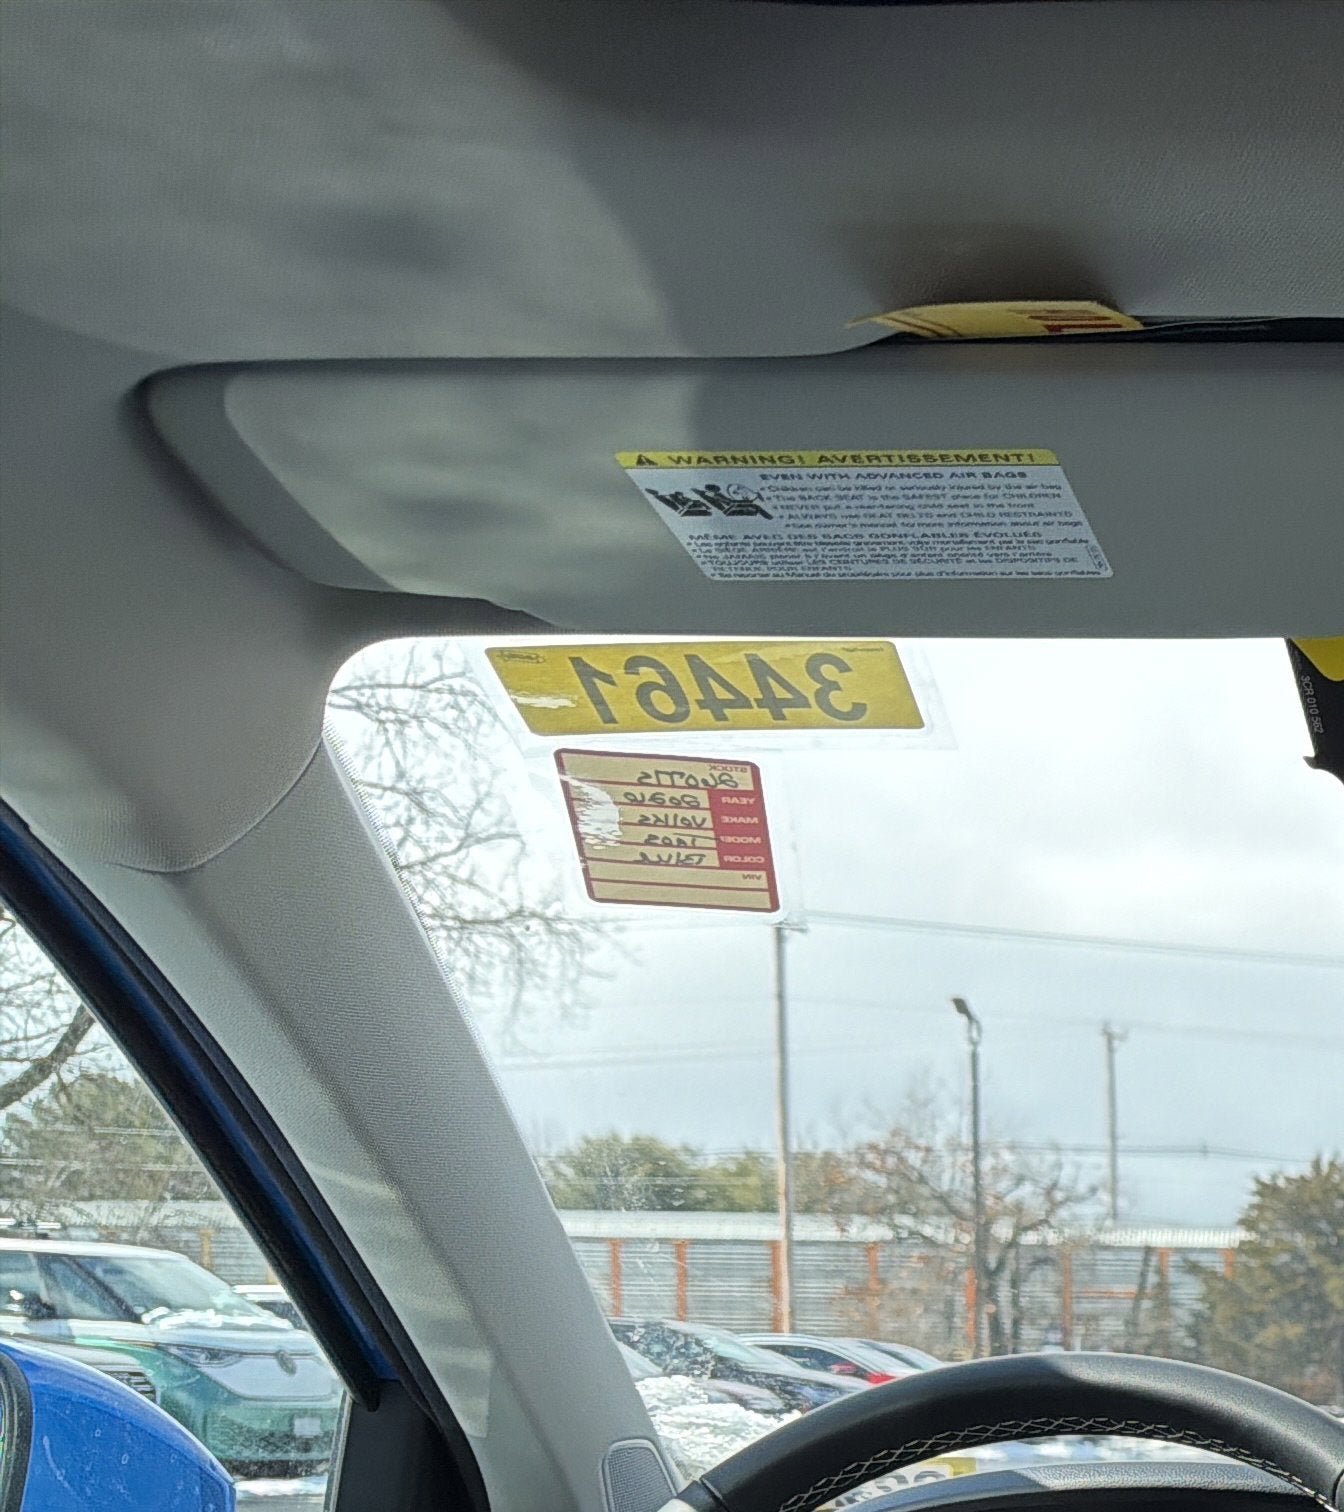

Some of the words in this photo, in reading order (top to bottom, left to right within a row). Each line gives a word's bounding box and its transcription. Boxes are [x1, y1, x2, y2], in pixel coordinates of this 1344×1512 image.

[667, 455, 804, 465] WARNING!
[817, 453, 1035, 464] AVERTISSEMENT!
[855, 472, 944, 480] ADVANCED
[982, 471, 1027, 479] BAGS
